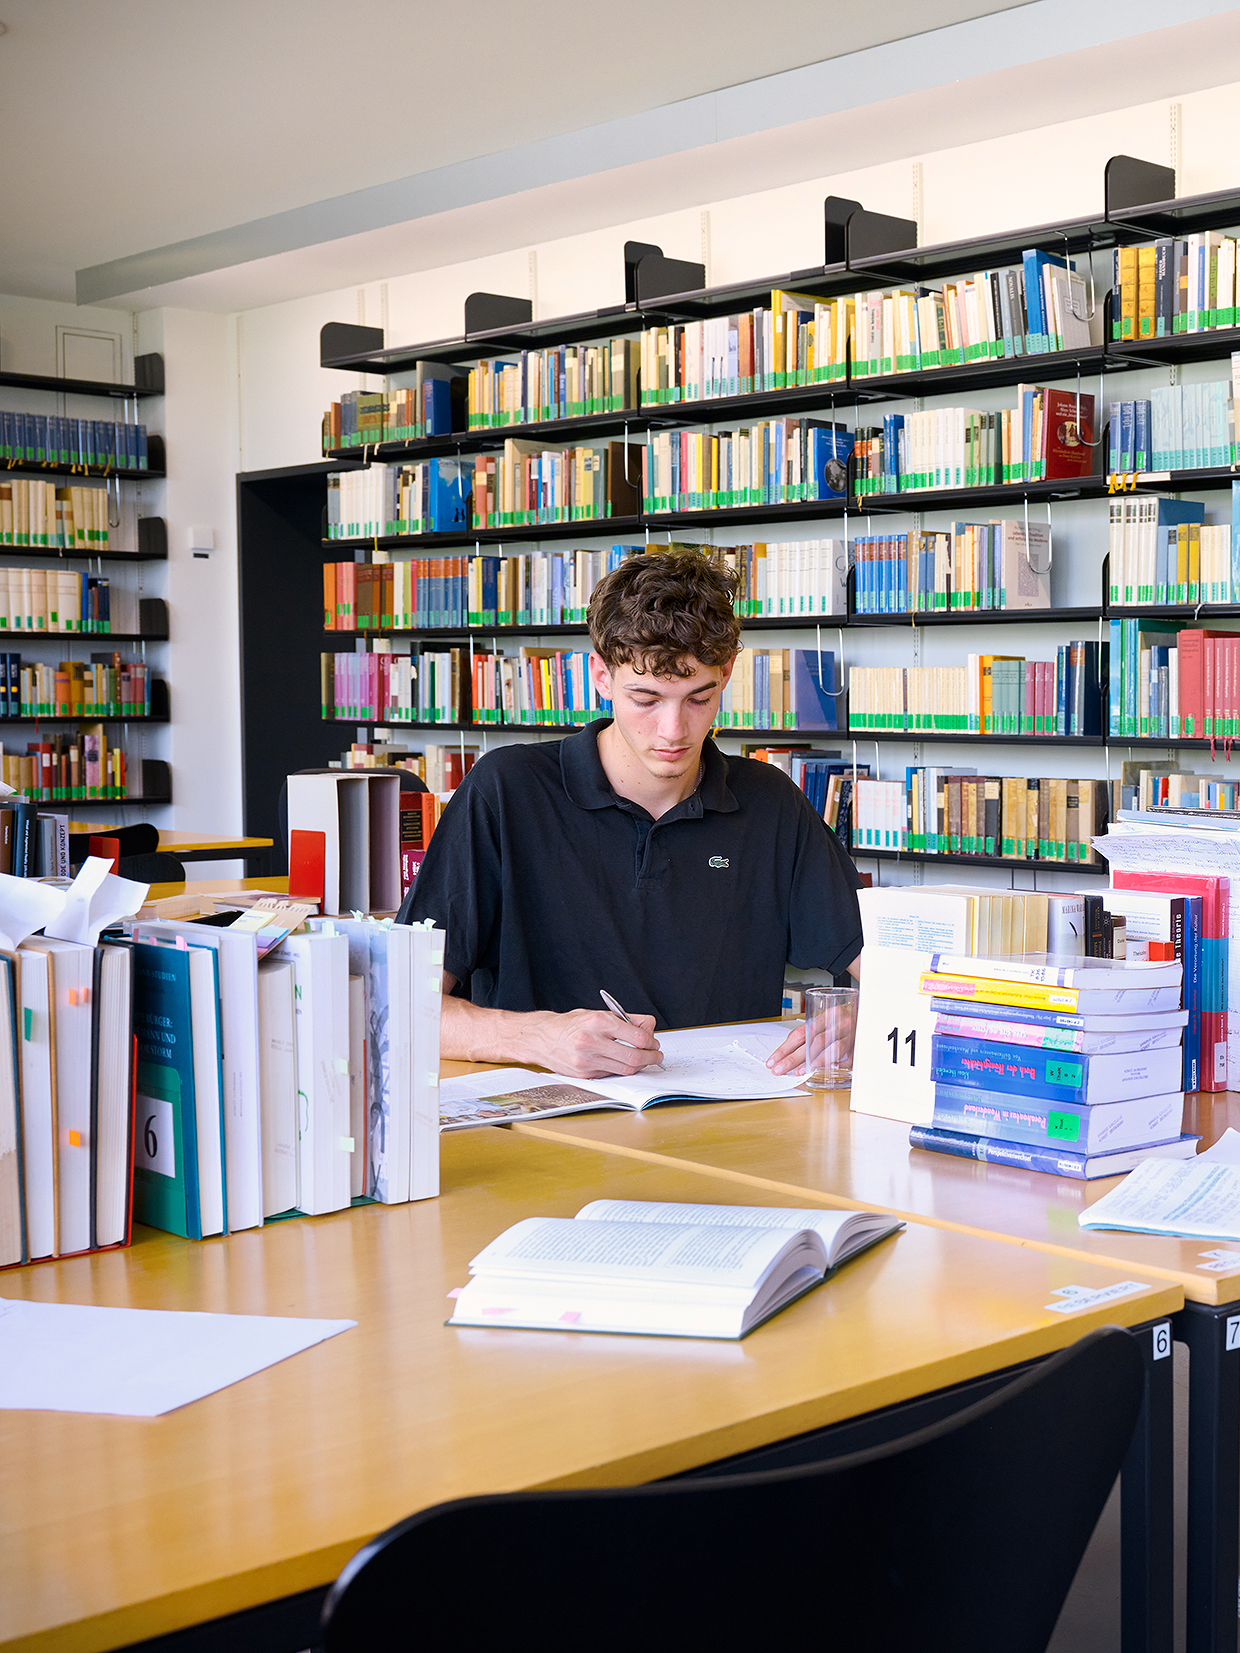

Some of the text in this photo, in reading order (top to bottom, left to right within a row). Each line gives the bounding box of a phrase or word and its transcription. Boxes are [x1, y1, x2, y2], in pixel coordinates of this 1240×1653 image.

[151, 1046, 172, 1059] STORM
[887, 1027, 917, 1067] 11
[961, 1058, 1036, 1079] Buch der Königstöchter
[964, 1104, 1046, 1128] Pocahontas in Wonderland
[144, 1114, 158, 1158] 6
[1157, 1329, 1167, 1353] 6
[1230, 1322, 1240, 1344] 7
